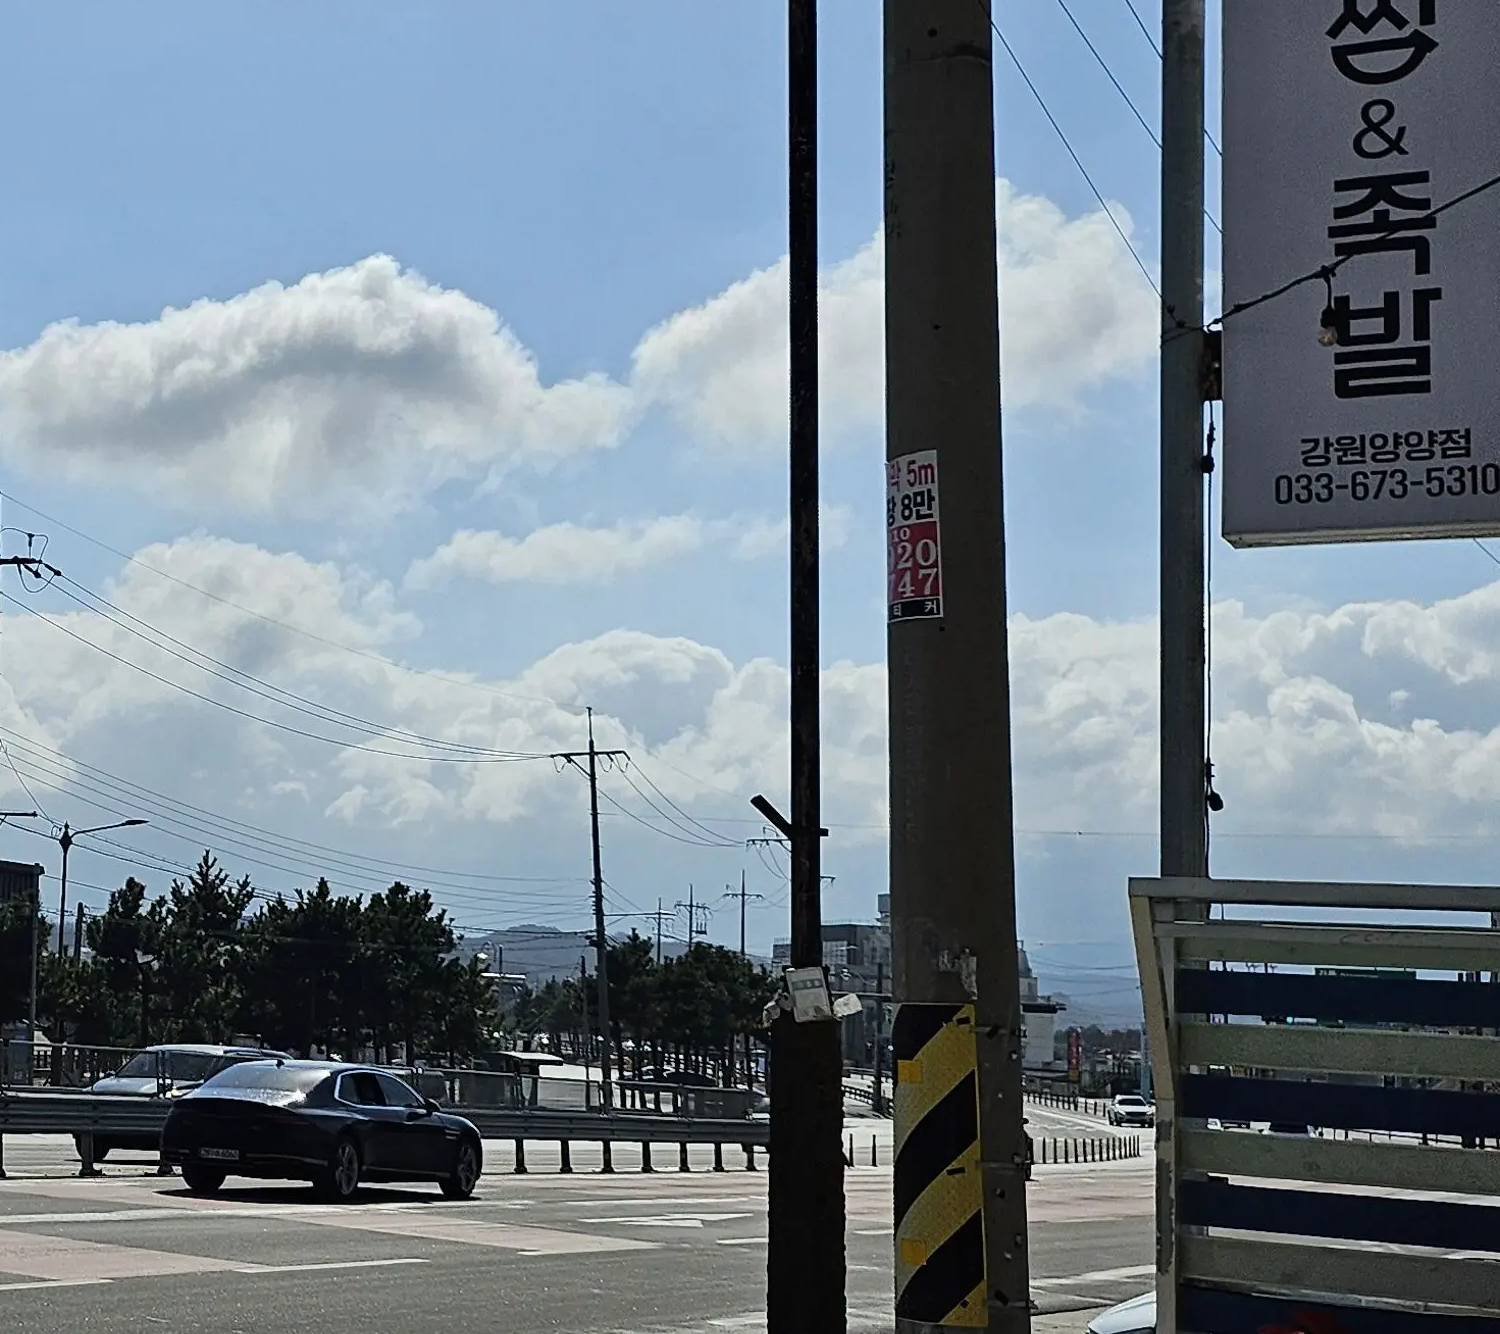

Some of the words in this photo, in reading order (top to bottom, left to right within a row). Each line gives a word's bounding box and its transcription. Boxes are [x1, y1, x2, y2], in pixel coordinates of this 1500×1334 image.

[1300, 428, 1472, 467] 강원양양점
[907, 459, 935, 487] 5m
[1274, 463, 1500, 505] 033-673-5310
[901, 488, 935, 521] 8만
